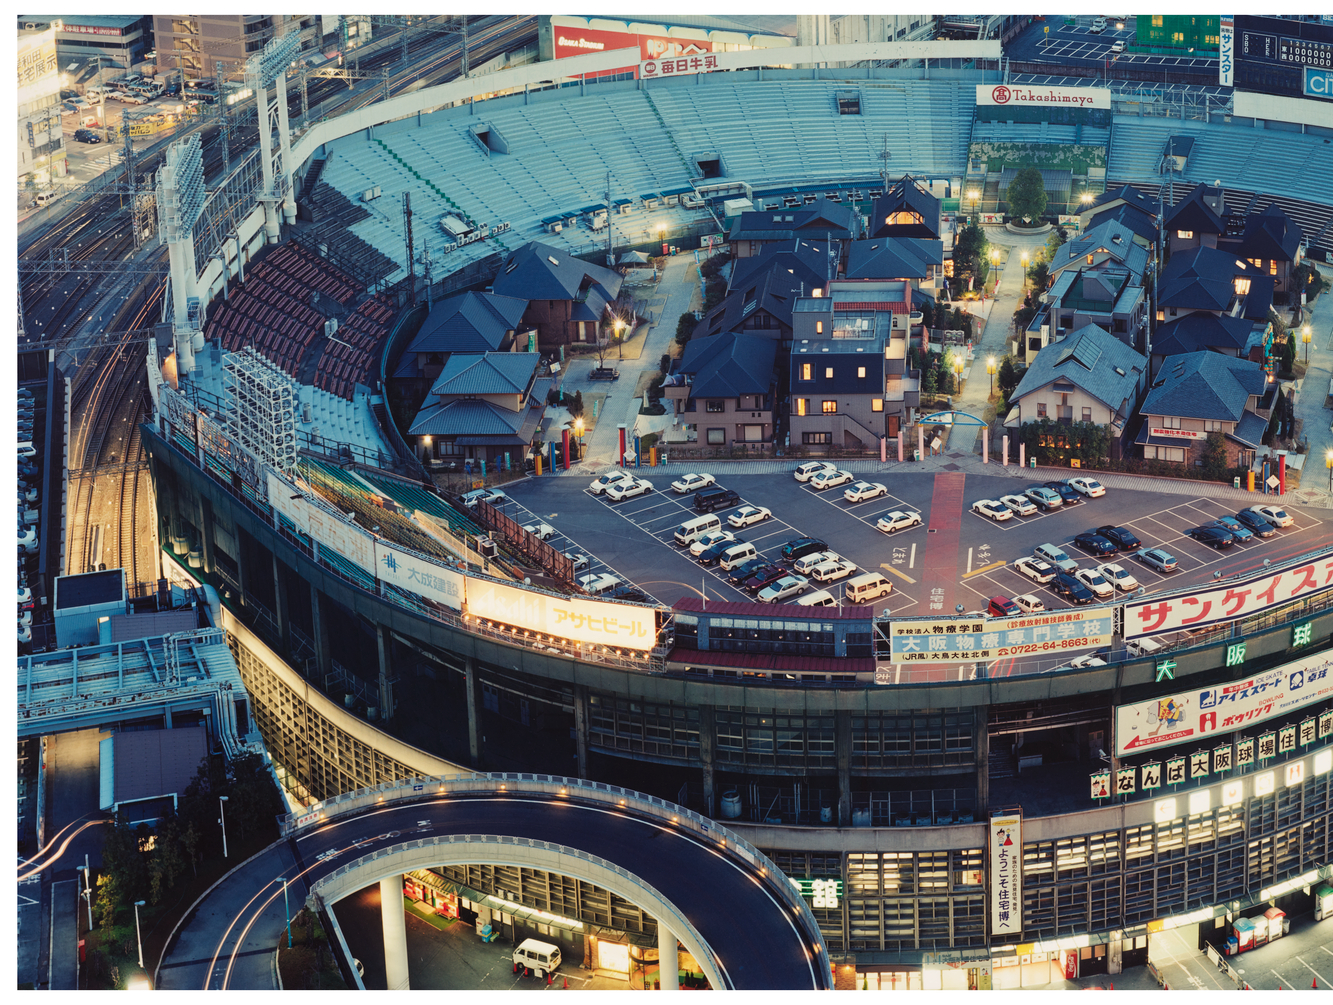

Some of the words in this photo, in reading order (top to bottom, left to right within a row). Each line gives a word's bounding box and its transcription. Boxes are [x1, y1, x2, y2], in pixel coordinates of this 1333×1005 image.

[661, 55, 718, 74] 毎日牛乳
[1222, 34, 1232, 83] サンスター
[1013, 90, 1093, 106] Takashimaya
[408, 567, 460, 599] 大成建設
[475, 587, 540, 625] Asahi
[930, 588, 944, 610] 住宅博
[553, 608, 647, 637] アサヒビール
[933, 624, 983, 634] 物療学園
[902, 620, 1101, 651] 大阪物療専門学校
[1010, 638, 1088, 654] 0722-64-8663
[1266, 670, 1283, 681] SKATE
[1307, 668, 1328, 683] 卓球
[1218, 678, 1282, 705] アイススケート
[1259, 693, 1284, 706] BOWLING
[1222, 703, 1272, 727] ボウリング
[998, 848, 1009, 928] ようこそ住宅博へ
